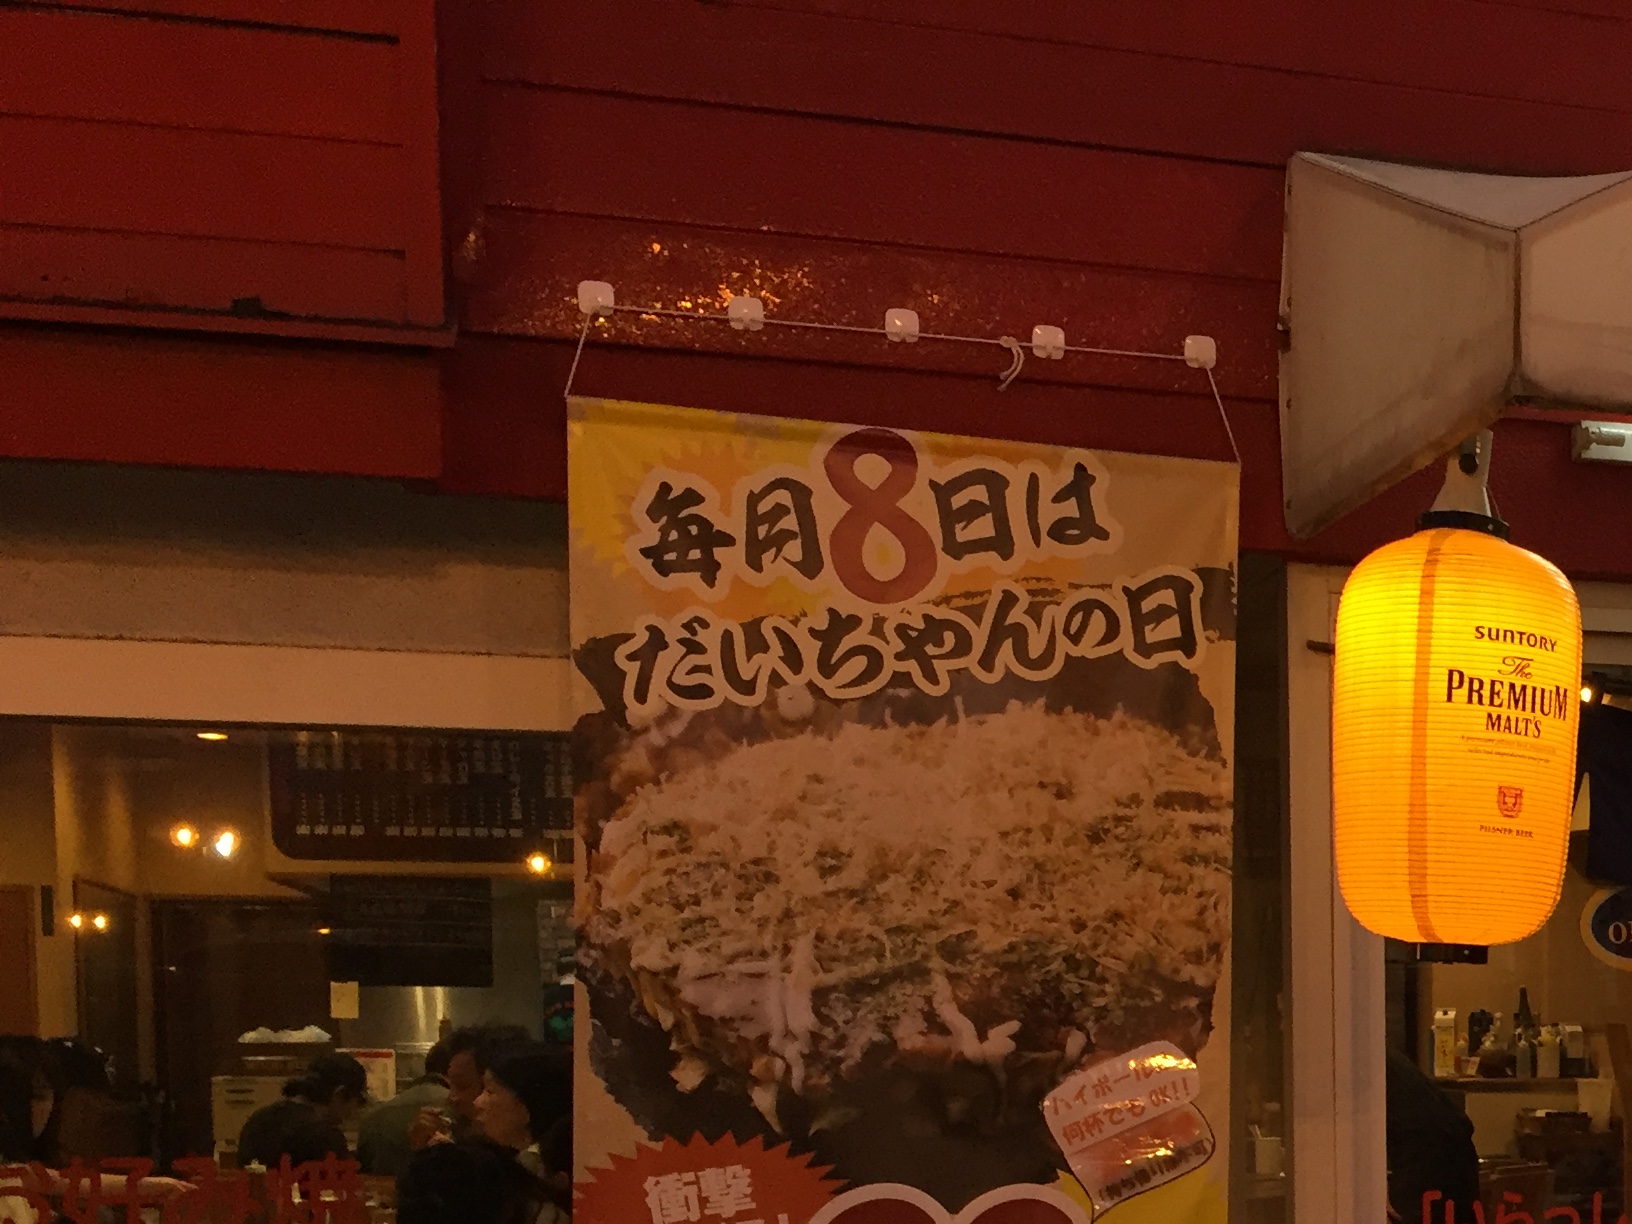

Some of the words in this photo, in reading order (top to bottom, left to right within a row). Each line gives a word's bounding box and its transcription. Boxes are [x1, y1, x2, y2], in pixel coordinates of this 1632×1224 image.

[639, 428, 1109, 604] 毎月8日は
[621, 573, 1199, 705] だいちゃんの日
[1475, 625, 1557, 652] SUNTORY
[1498, 656, 1534, 679] The
[1446, 669, 1568, 721] PREMIUM
[1485, 712, 1541, 738] MALT'S
